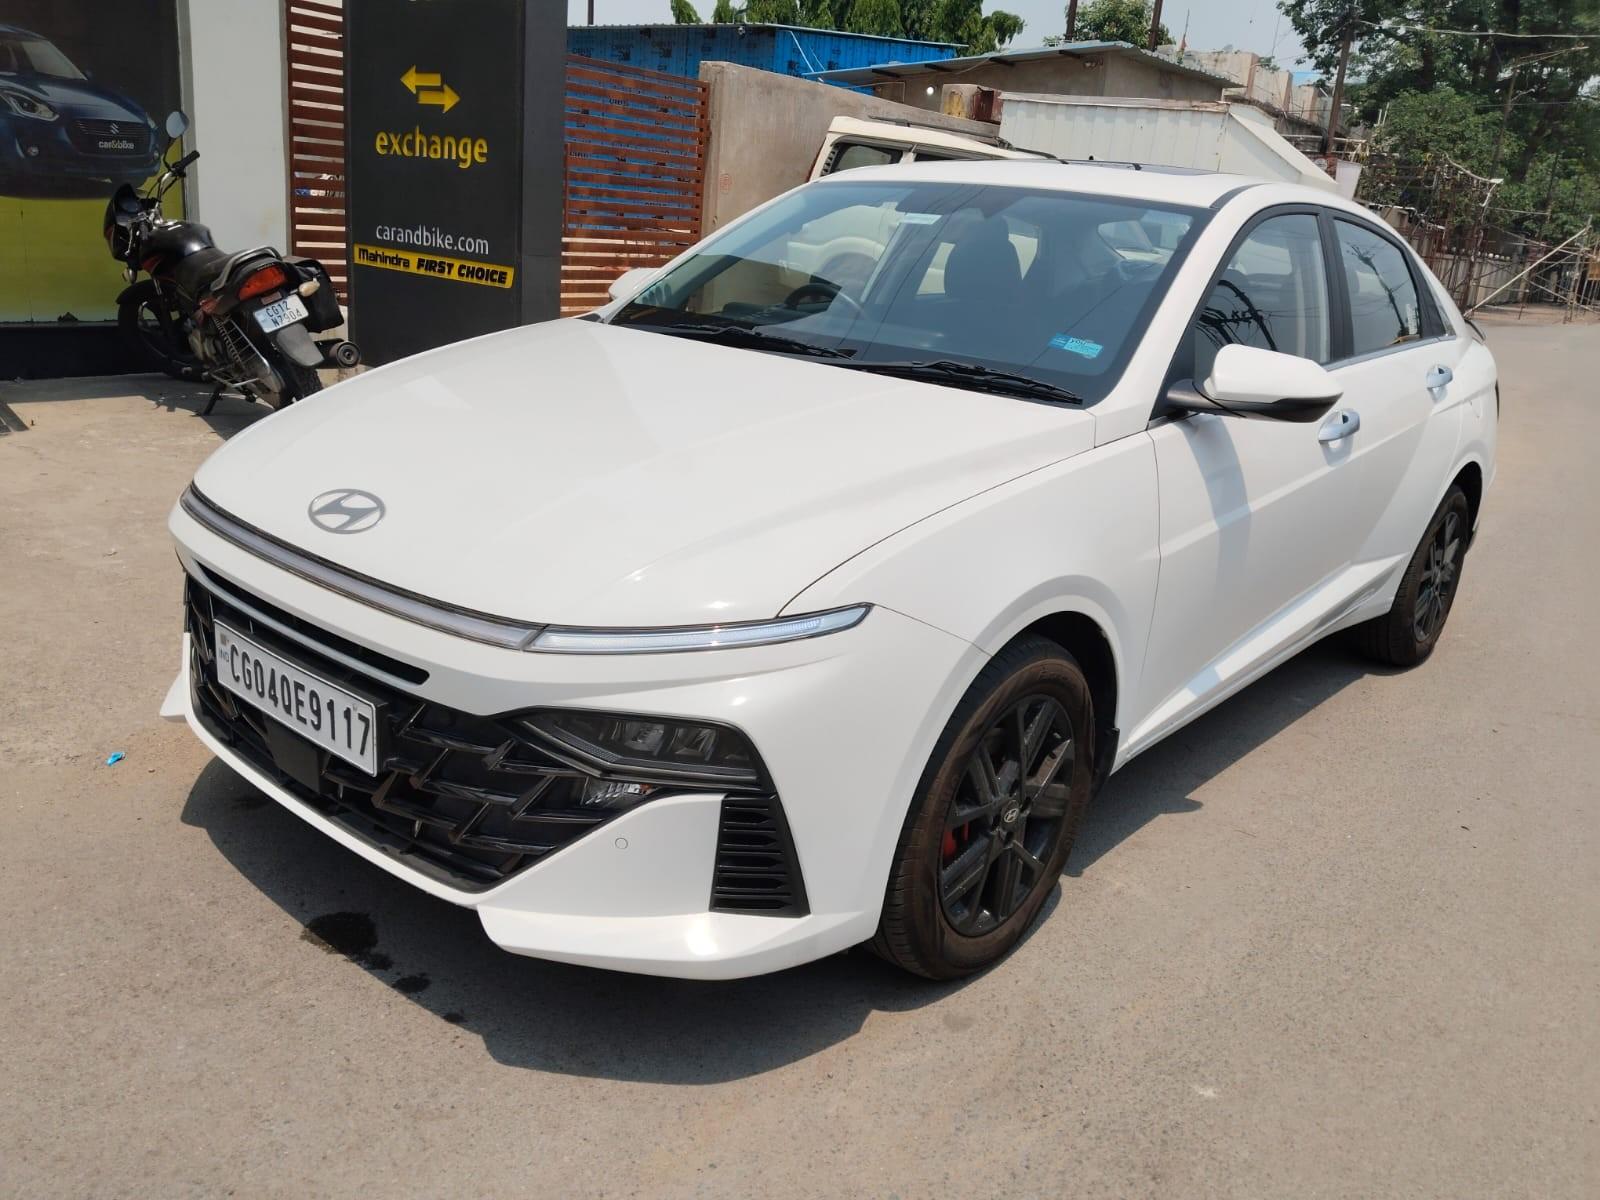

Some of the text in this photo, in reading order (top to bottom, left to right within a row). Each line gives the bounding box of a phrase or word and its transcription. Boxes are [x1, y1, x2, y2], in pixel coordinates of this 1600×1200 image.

[375, 125, 488, 169] exchange
[375, 224, 489, 255] carandbike.com
[358, 248, 508, 284] Mahindra FIRST CHOICE
[265, 300, 290, 318] CG12
[230, 644, 370, 756] CG04QE9117
